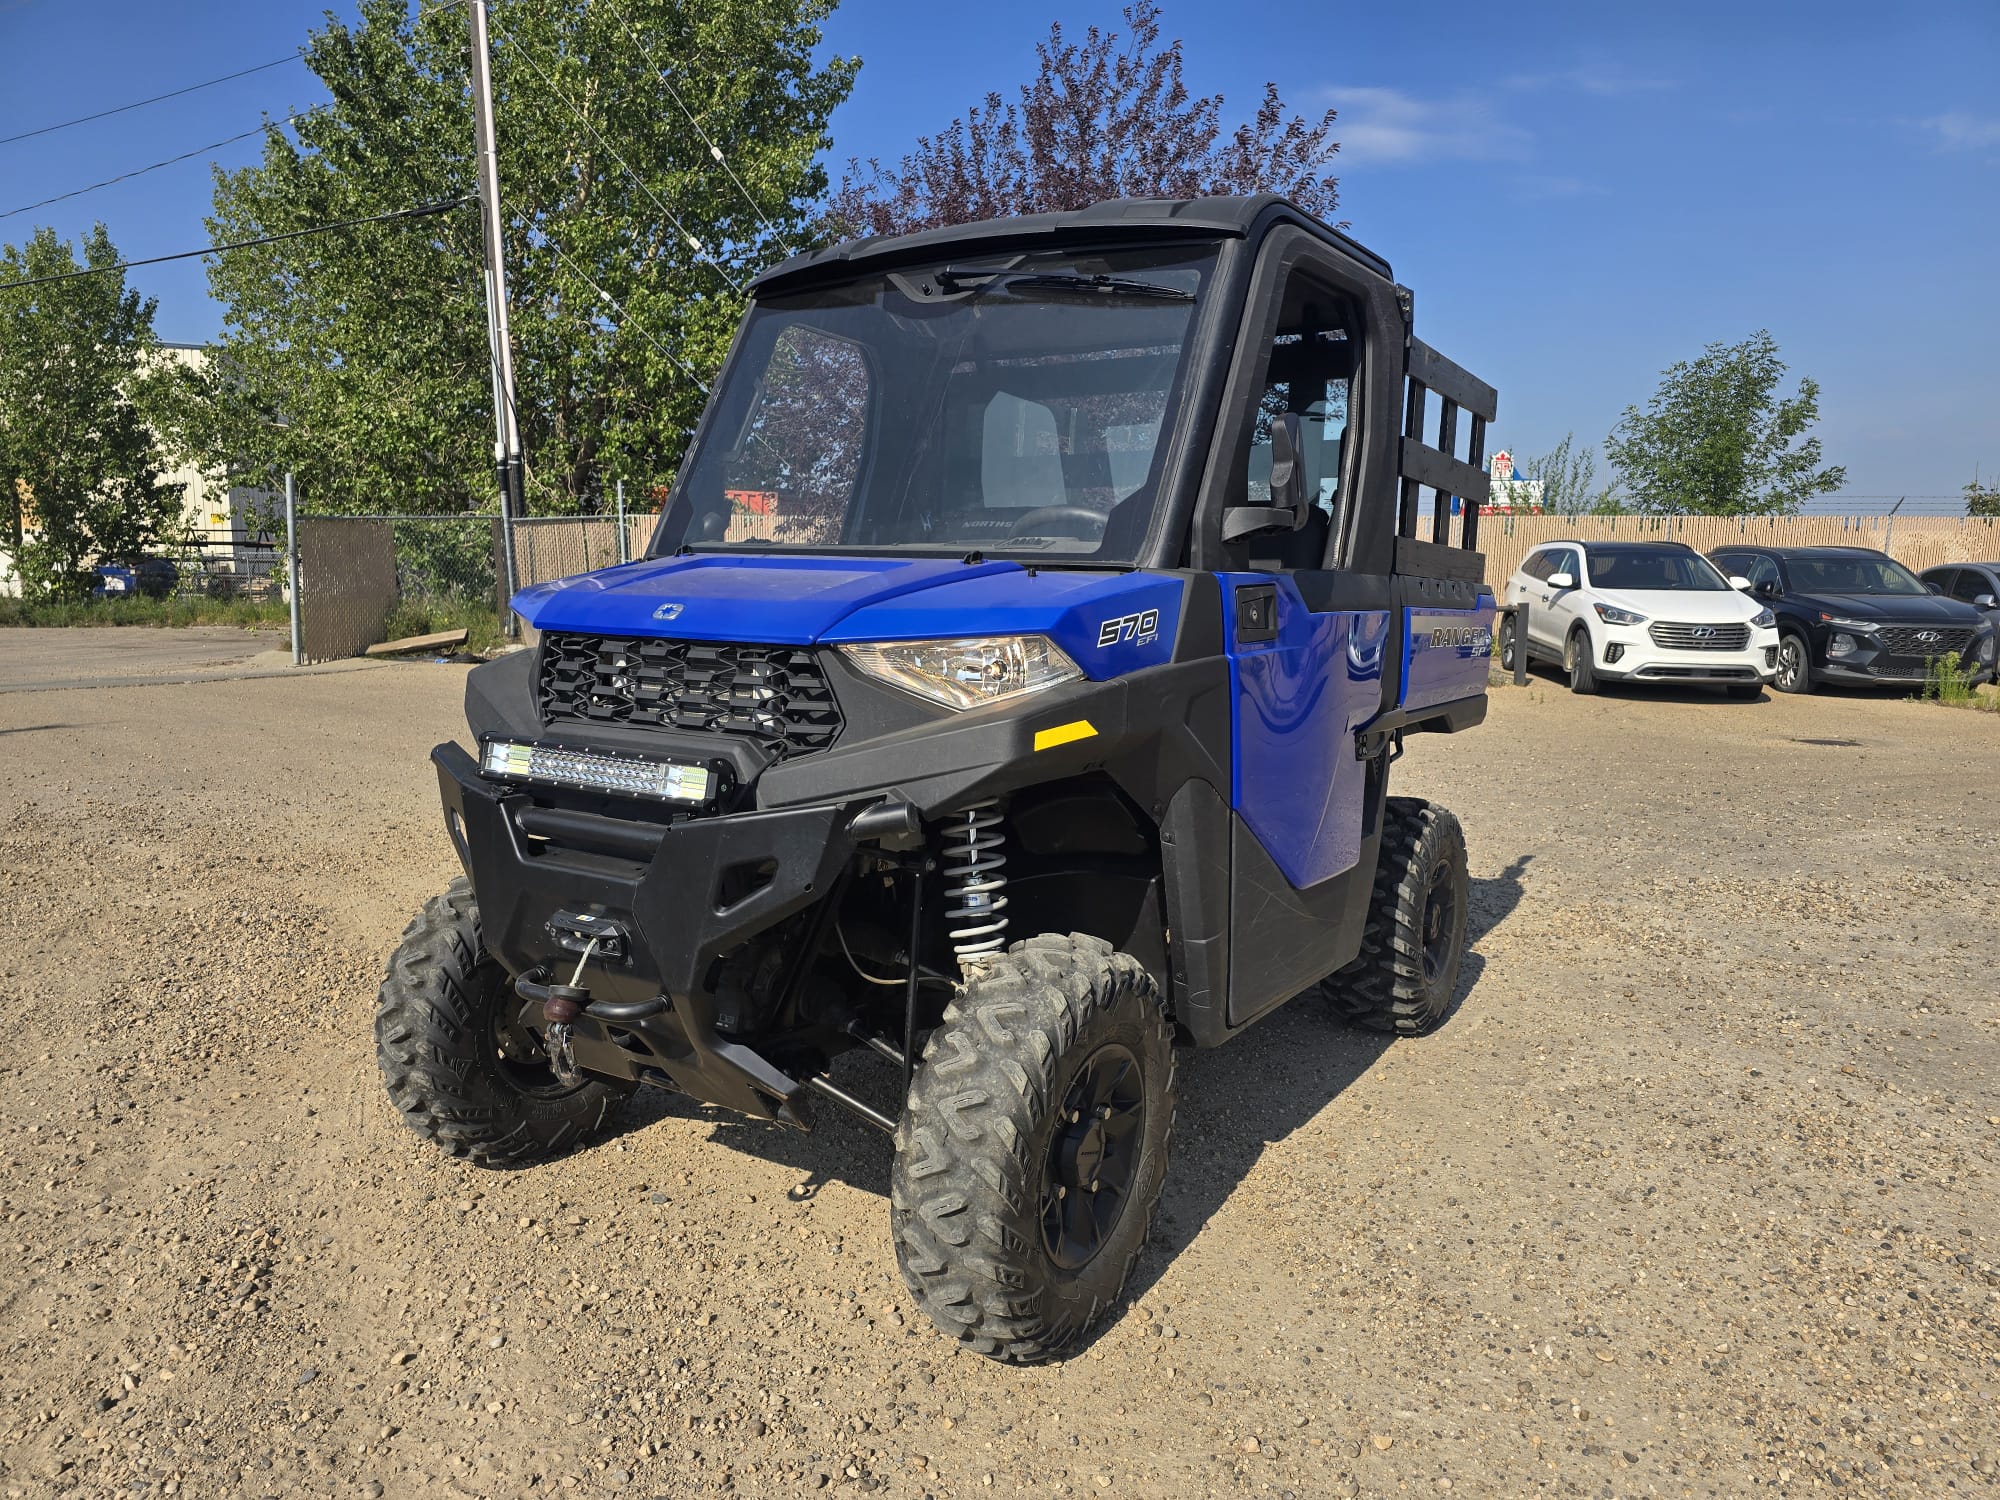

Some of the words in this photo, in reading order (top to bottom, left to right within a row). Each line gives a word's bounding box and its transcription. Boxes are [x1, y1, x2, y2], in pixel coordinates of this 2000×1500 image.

[961, 521, 1016, 529] NORTHS
[1097, 608, 1159, 648] 570
[1136, 633, 1159, 647] EFI
[1430, 626, 1487, 648] RANGER
[1470, 647, 1486, 657] SP
